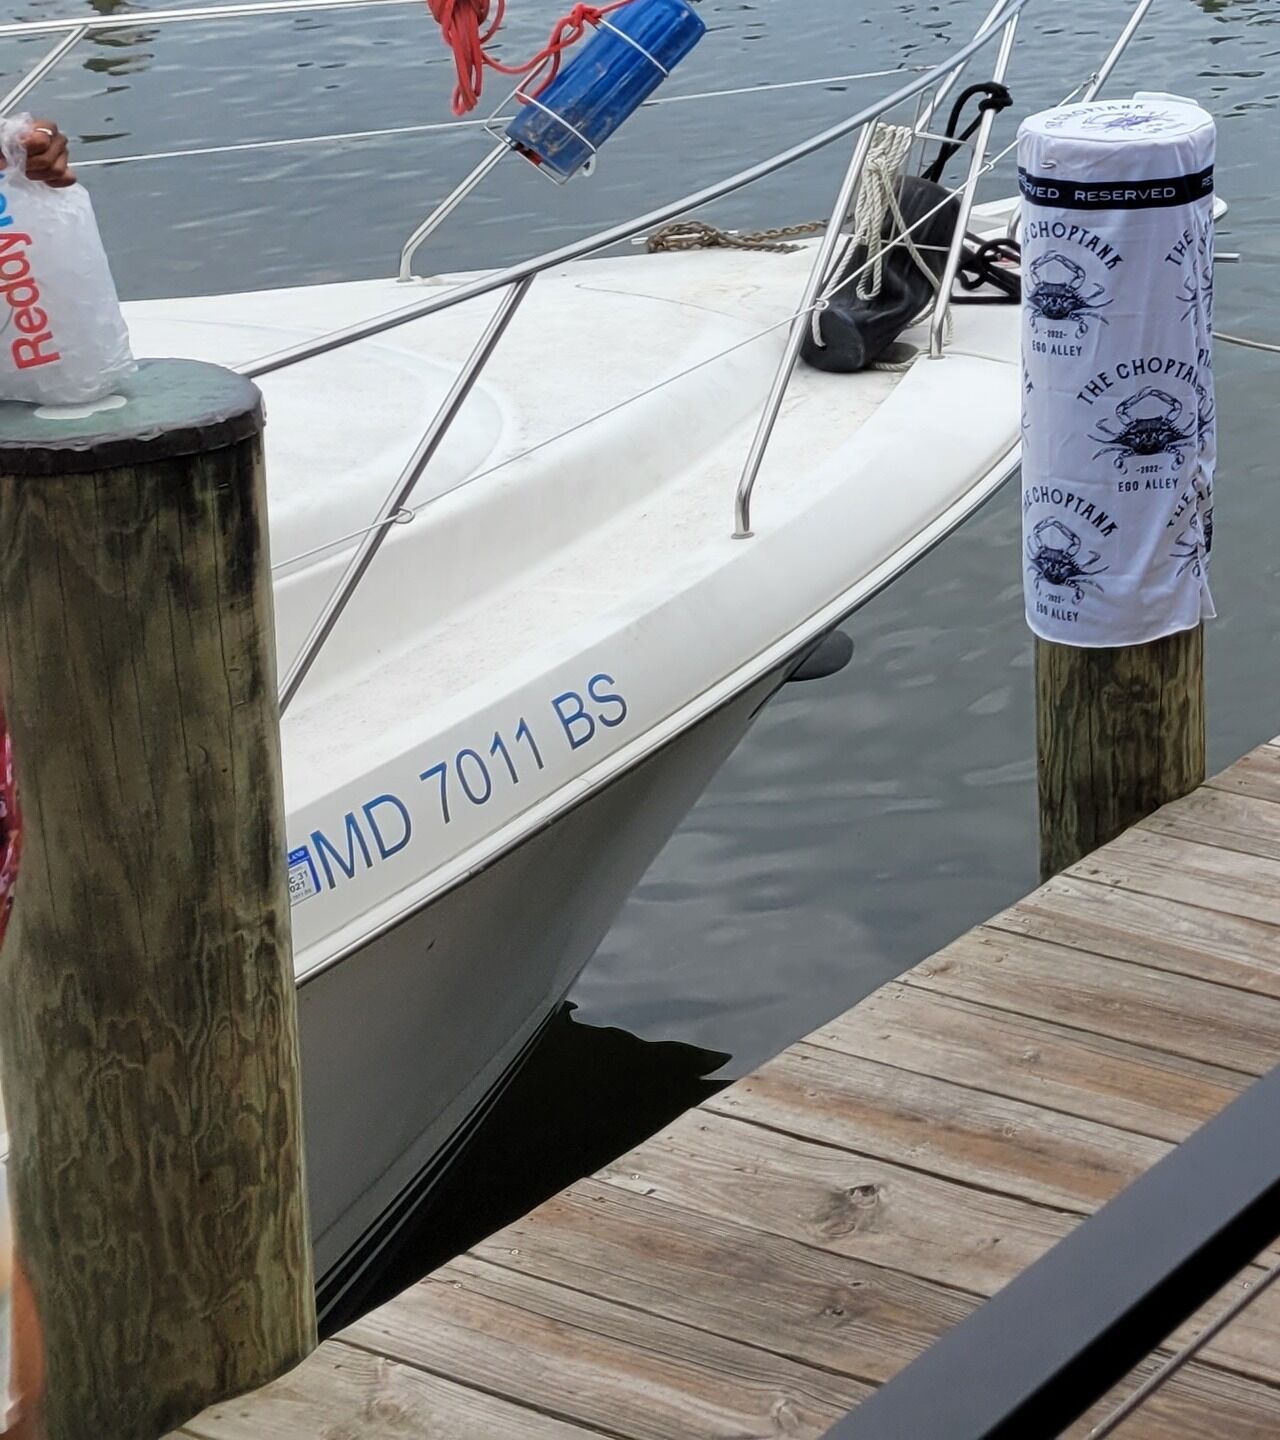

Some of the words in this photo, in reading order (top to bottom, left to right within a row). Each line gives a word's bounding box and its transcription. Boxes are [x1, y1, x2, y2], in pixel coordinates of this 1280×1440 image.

[1074, 187, 1176, 202] RESERVED
[1029, 220, 1124, 271] CHOPTANK
[1164, 229, 1194, 267] THE
[1032, 339, 1047, 353] EGO
[1051, 342, 1083, 357] ALLEY
[1077, 371, 1114, 406] THE
[1118, 481, 1139, 493] EGO
[1145, 478, 1180, 491] ALLEY
[1031, 485, 1120, 538] CHOPTANK
[1050, 605, 1079, 623] ALLEY
[310, 793, 412, 890] MD
[419, 717, 545, 824] 7011
[551, 673, 628, 750] BS
